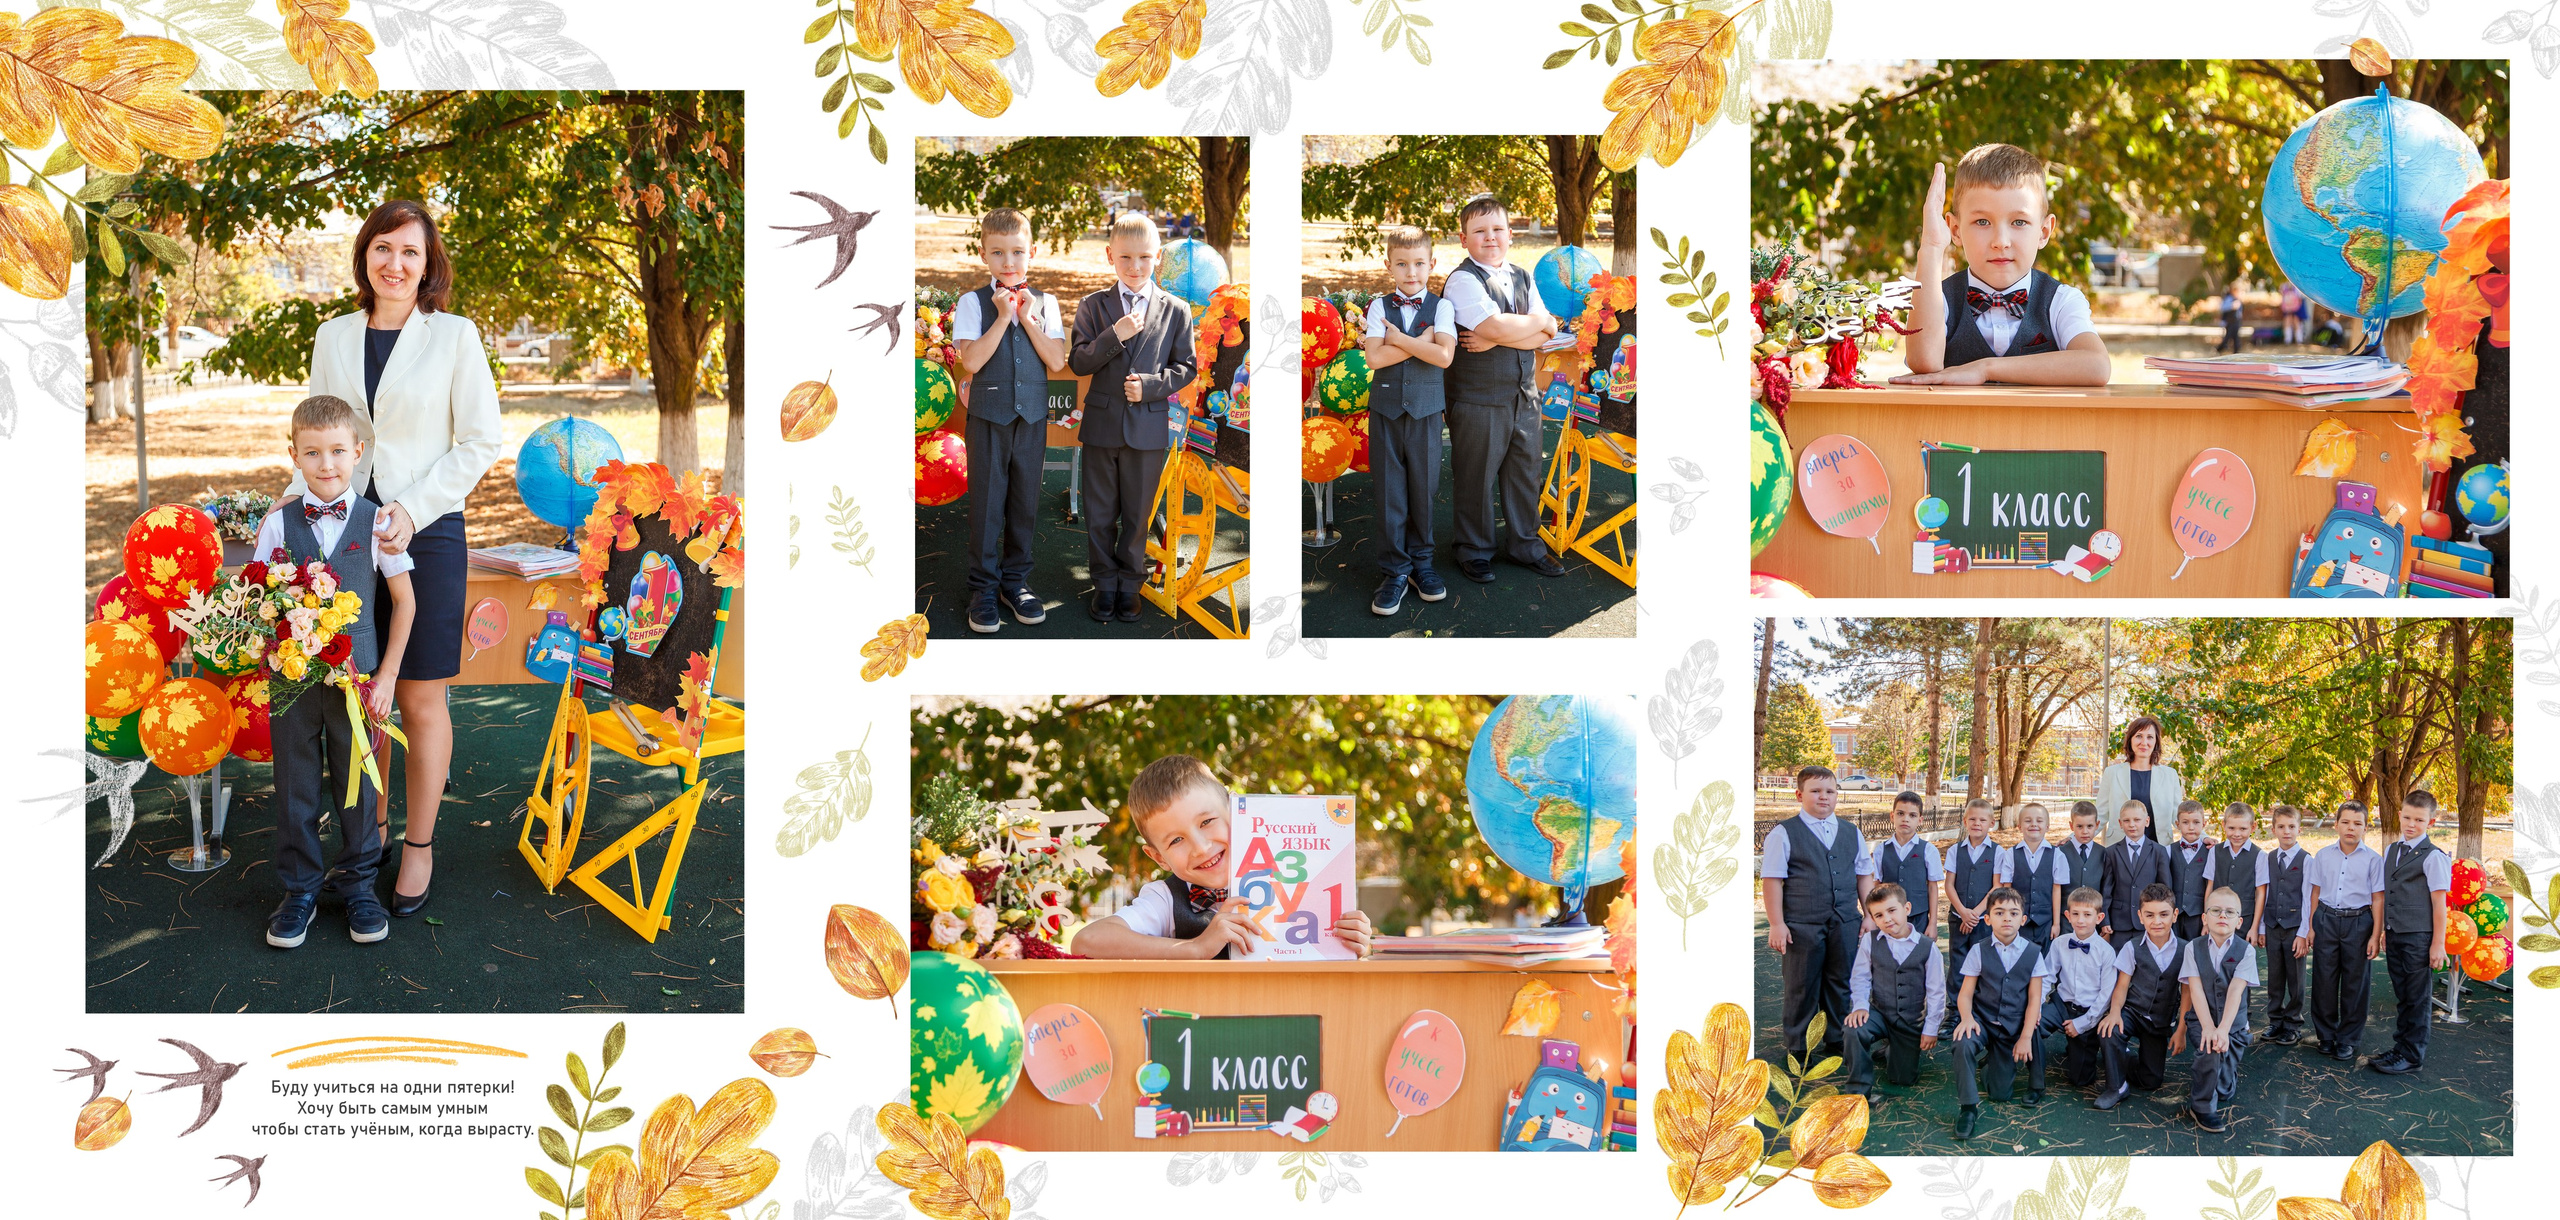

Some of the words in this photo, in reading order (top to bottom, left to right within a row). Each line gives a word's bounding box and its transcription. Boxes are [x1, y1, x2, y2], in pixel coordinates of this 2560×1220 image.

[1048, 395, 1072, 409] асс
[1611, 383, 1637, 392] СЕНТЯБР
[1837, 476, 1855, 492] за
[1957, 462, 1972, 526] 1
[1992, 492, 2091, 527] класс
[1822, 493, 1888, 531] знаниями
[594, 859, 600, 867] 10
[618, 843, 625, 851] 20
[642, 825, 649, 834] 30
[668, 807, 675, 816] 40
[690, 791, 699, 800] 50
[1251, 817, 1317, 836] Русский
[1323, 883, 1342, 931] 1
[1060, 1044, 1077, 1060] за
[1177, 1028, 1192, 1091] 1
[1212, 1055, 1308, 1091] класс
[1045, 1060, 1110, 1098] знаниями
